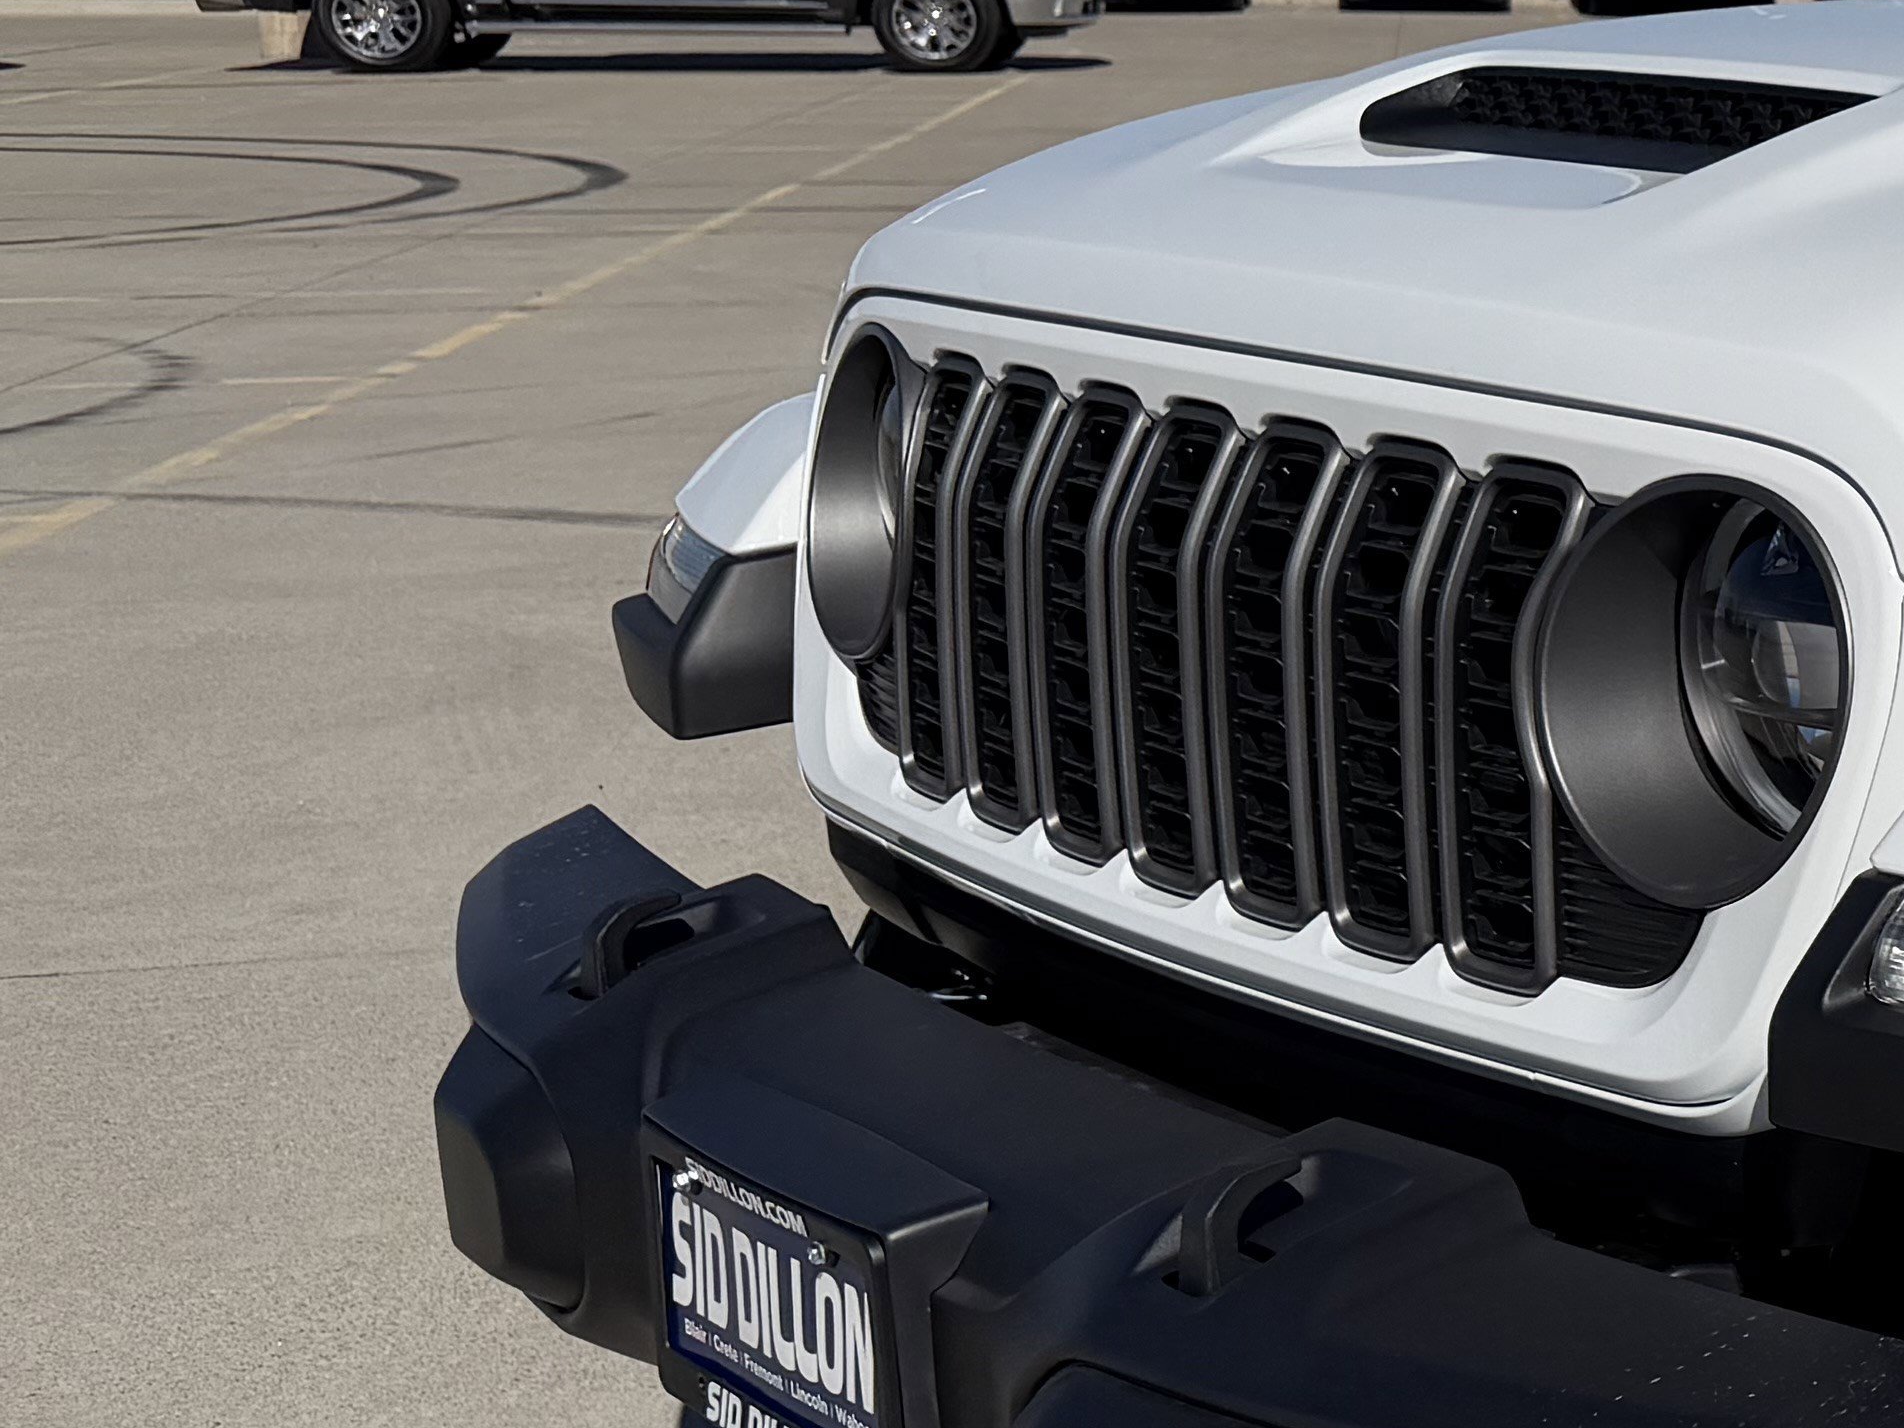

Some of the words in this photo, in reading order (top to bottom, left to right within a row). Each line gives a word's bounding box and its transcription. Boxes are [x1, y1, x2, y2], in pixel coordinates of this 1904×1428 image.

[685, 1157, 809, 1237] SIDDILLON.COM
[672, 1192, 729, 1329] SID
[732, 1227, 874, 1415] DILLON
[790, 1379, 828, 1416] Lincoln
